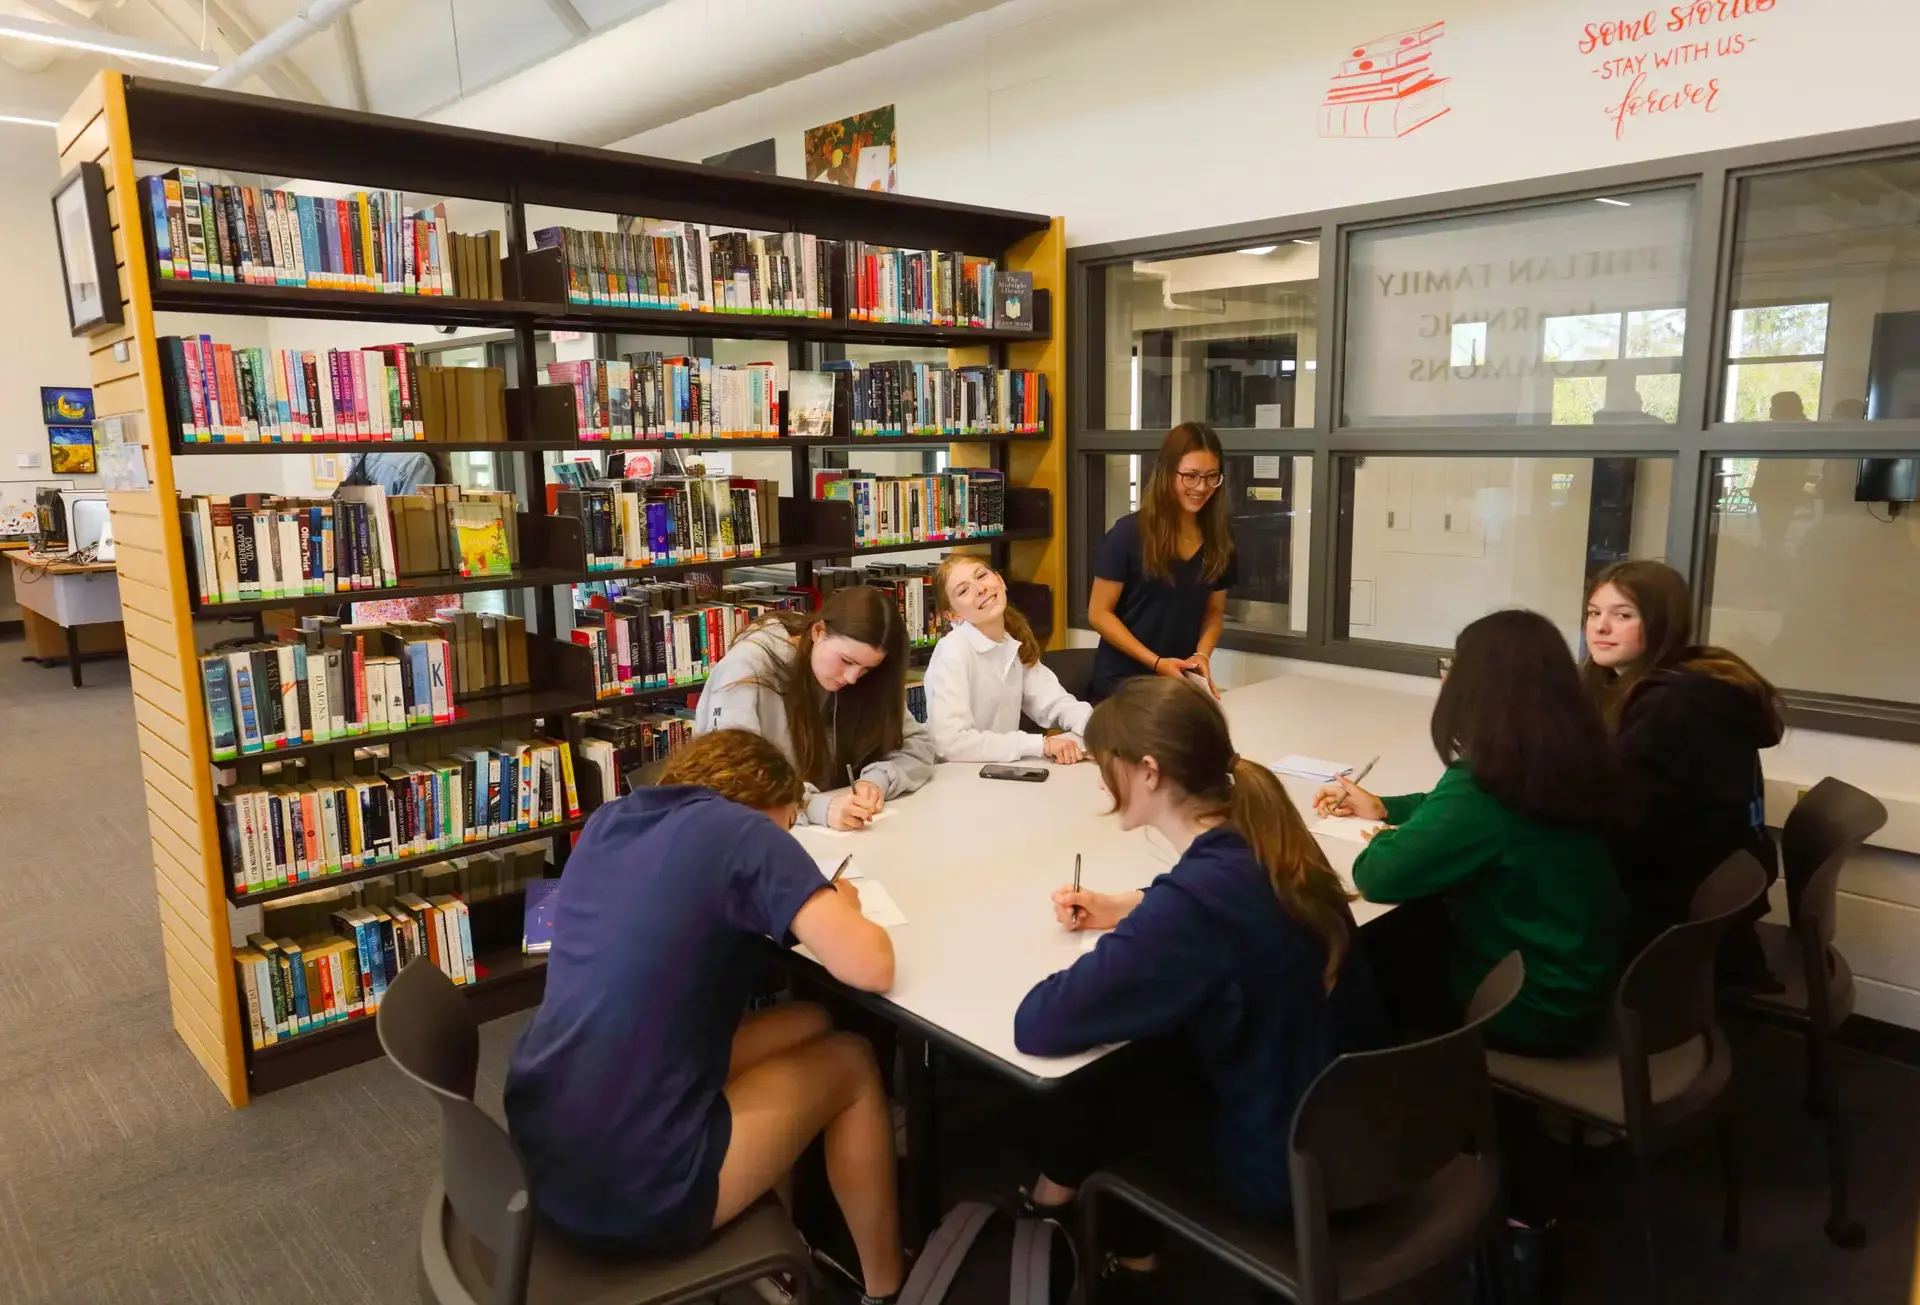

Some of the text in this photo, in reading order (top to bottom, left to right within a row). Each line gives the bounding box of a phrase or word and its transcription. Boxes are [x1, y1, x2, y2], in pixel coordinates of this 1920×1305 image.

[1654, 42, 1709, 69] WITH
[1604, 72, 1720, 140] forever
[330, 352, 341, 400] SARAH DESSEN
[340, 352, 349, 376] SARAH
[690, 384, 699, 421] CORRECTIO
[236, 523, 248, 574] COPPERFIELD
[245, 537, 254, 561] DAVID
[301, 526, 311, 572] Oliver Twist
[362, 555, 370, 577] STARS
[267, 659, 280, 692] AKIN
[432, 662, 444, 687] K
[316, 675, 327, 721] DEMONS
[248, 835, 256, 866] WASHINGTON
